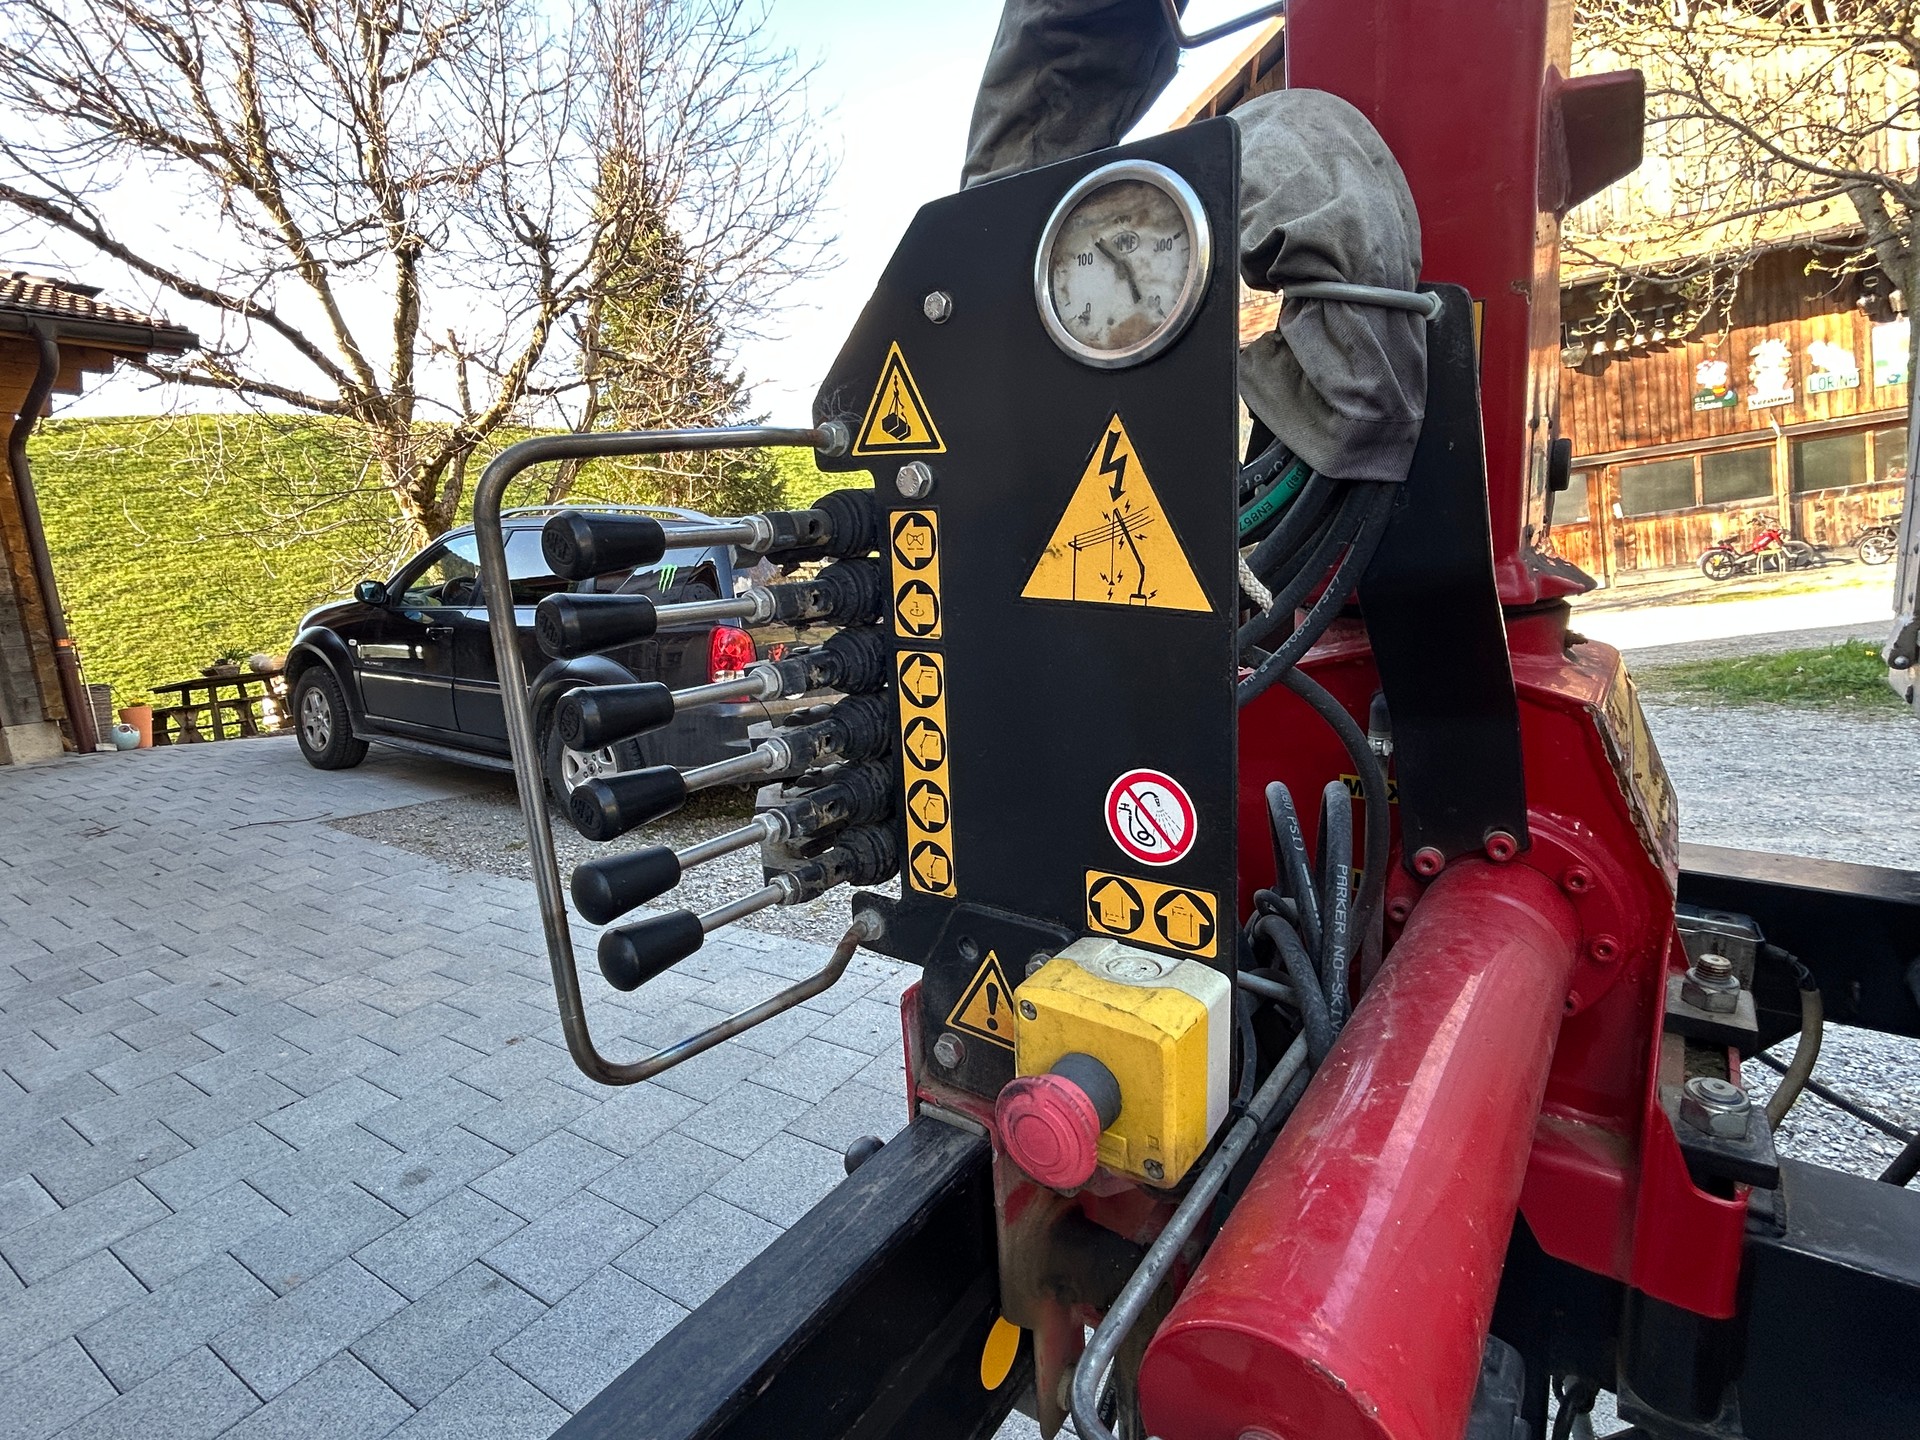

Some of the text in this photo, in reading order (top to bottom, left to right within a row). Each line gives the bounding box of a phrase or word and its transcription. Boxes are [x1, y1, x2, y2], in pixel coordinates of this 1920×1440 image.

[1077, 252, 1094, 266] 100
[1343, 778, 1400, 801] MX
[1287, 815, 1305, 852] PSI)
[1335, 864, 1348, 935] PARKER
